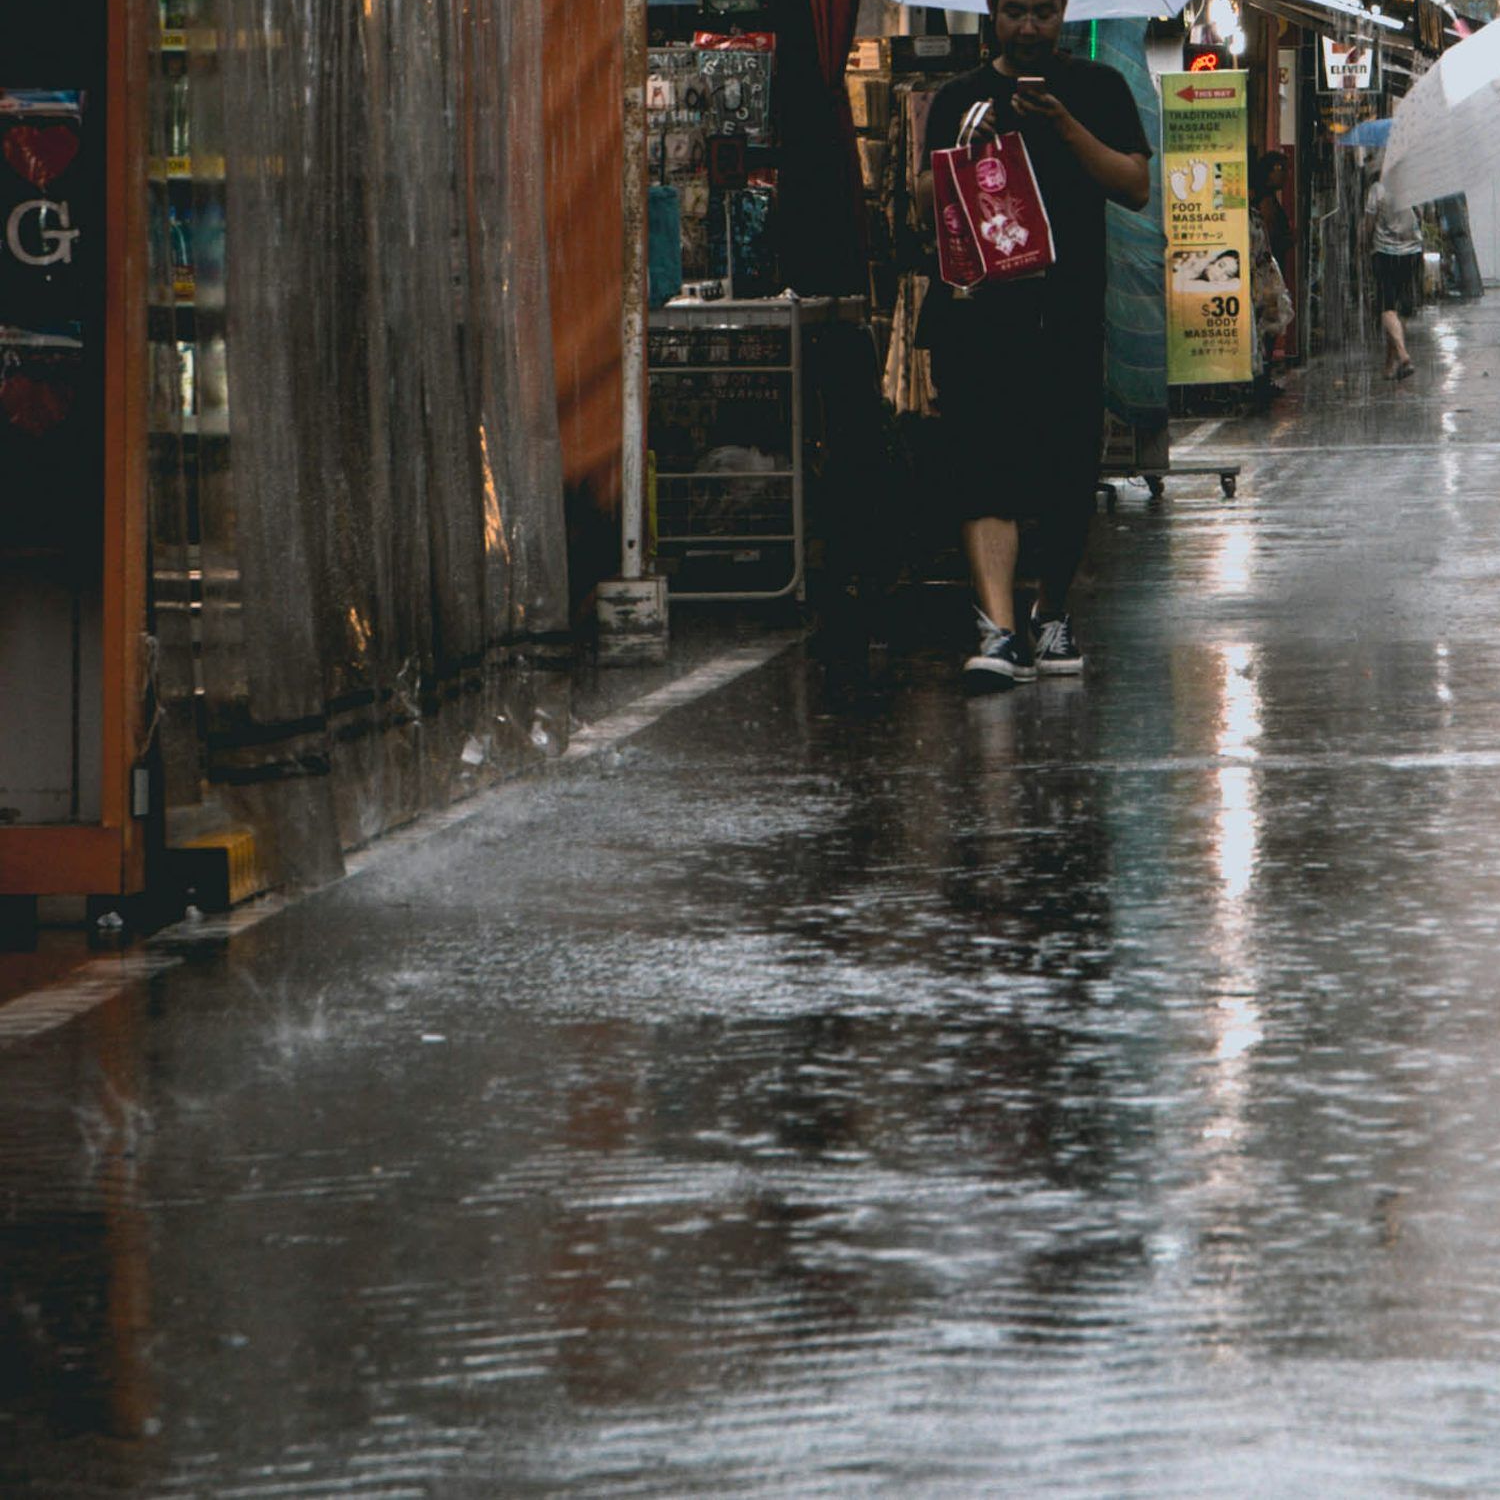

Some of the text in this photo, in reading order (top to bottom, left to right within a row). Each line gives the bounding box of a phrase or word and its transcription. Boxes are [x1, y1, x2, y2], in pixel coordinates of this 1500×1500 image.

[1213, 89, 1231, 97] WAY
[1169, 109, 1239, 120] TRADITIONAL
[1169, 121, 1221, 132] MASSAGE
[1171, 202, 1202, 212] FOOT
[1172, 213, 1227, 222] MASSAGE
[1201, 296, 1240, 318] $30
[1206, 317, 1238, 327] BODY
[1184, 327, 1239, 339] MASSAGE
